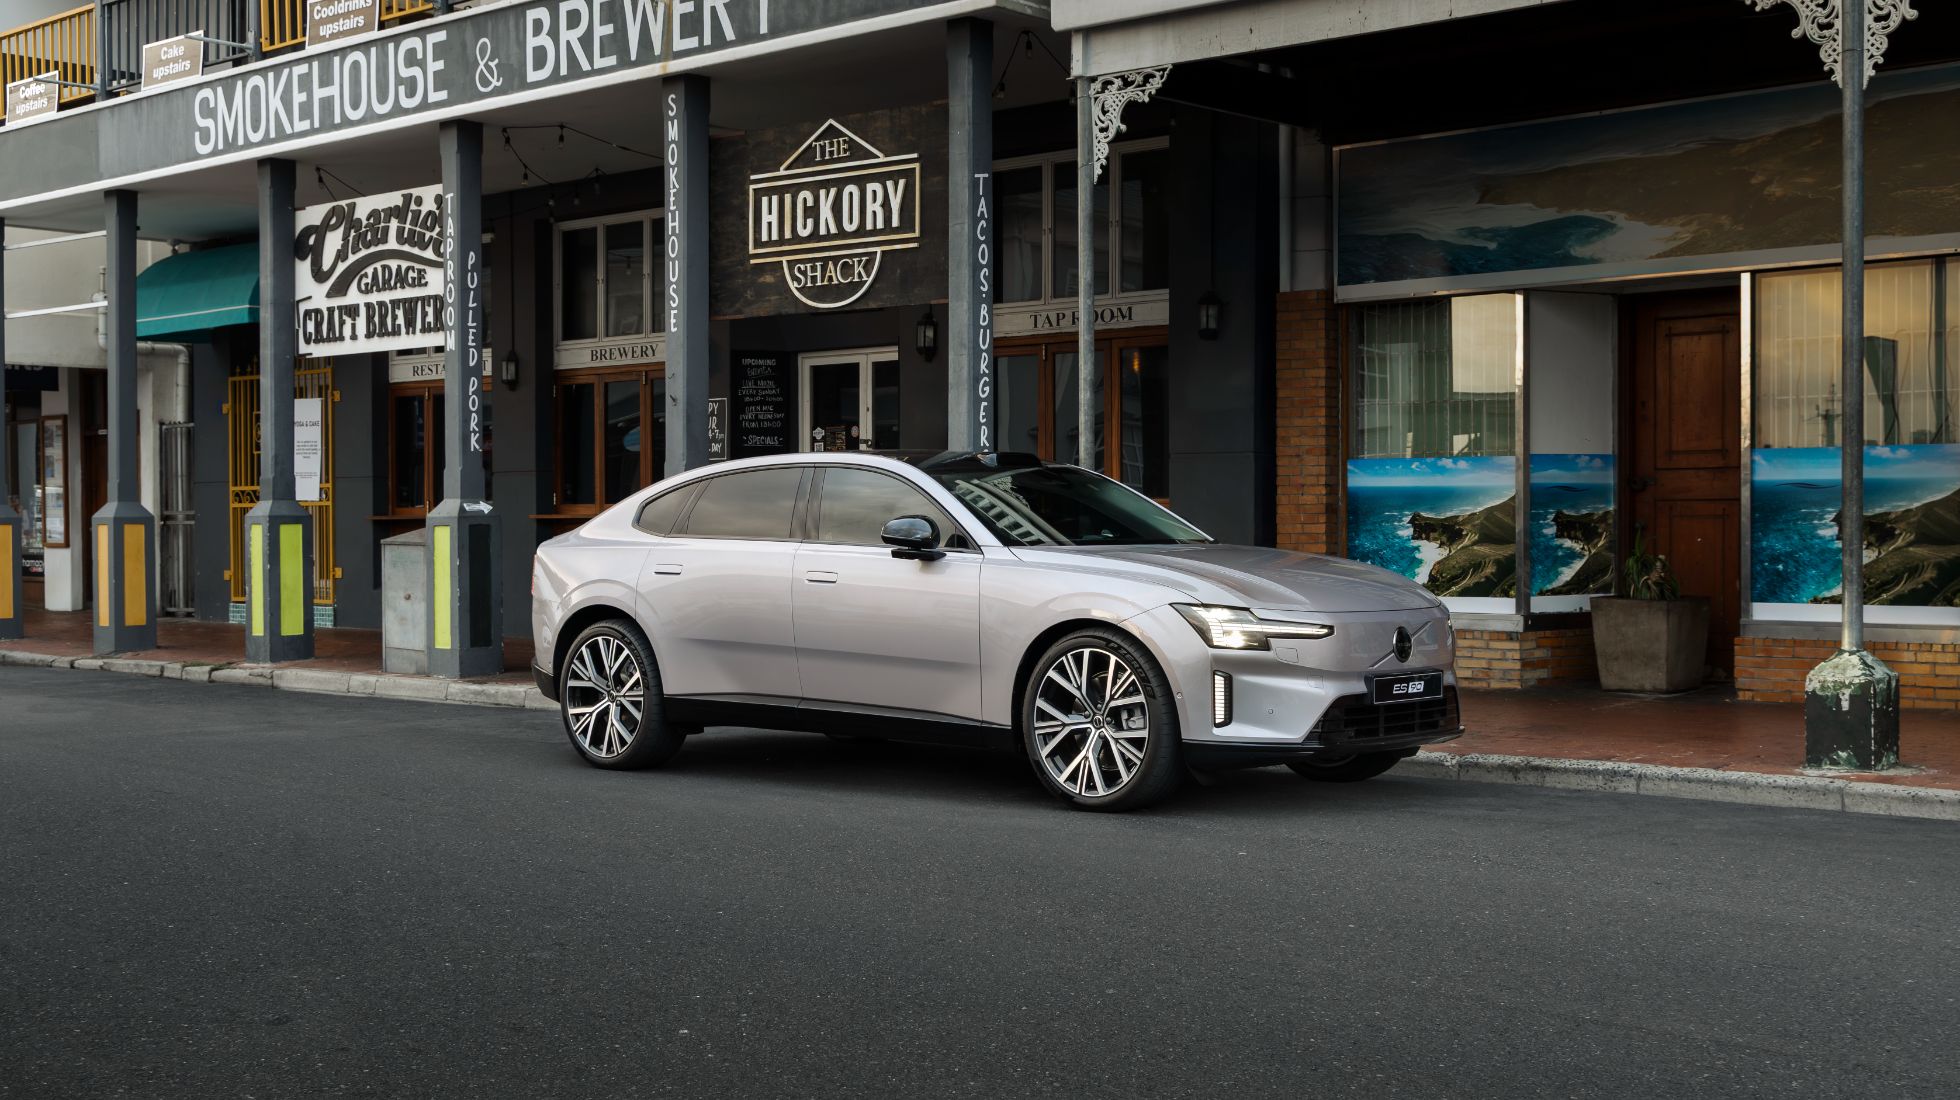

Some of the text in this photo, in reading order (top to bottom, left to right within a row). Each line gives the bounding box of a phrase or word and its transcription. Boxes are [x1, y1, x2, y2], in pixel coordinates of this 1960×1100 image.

[319, 15, 365, 38] upstairs
[160, 43, 185, 60] Cake
[152, 58, 191, 80] upstairs
[19, 82, 46, 98] Coffee
[194, 30, 448, 155] SMOKEHOUSE
[475, 37, 503, 93] &
[15, 96, 48, 115] upstairs
[812, 136, 849, 161] THE
[667, 93, 680, 333] SMOKEHOUSE
[761, 178, 907, 242] HICKORY
[356, 263, 429, 295] GARAGE
[793, 256, 870, 289] SHACK
[302, 303, 360, 345] CRAFT
[364, 294, 445, 339] BREWER
[1029, 311, 1066, 329] TAP
[467, 250, 480, 452] PULLED PORK
[590, 343, 659, 362] BREWERY
[741, 358, 776, 366] UPCOMING
[978, 304, 990, 453] BURGER
[747, 434, 779, 445] SPECIALS
